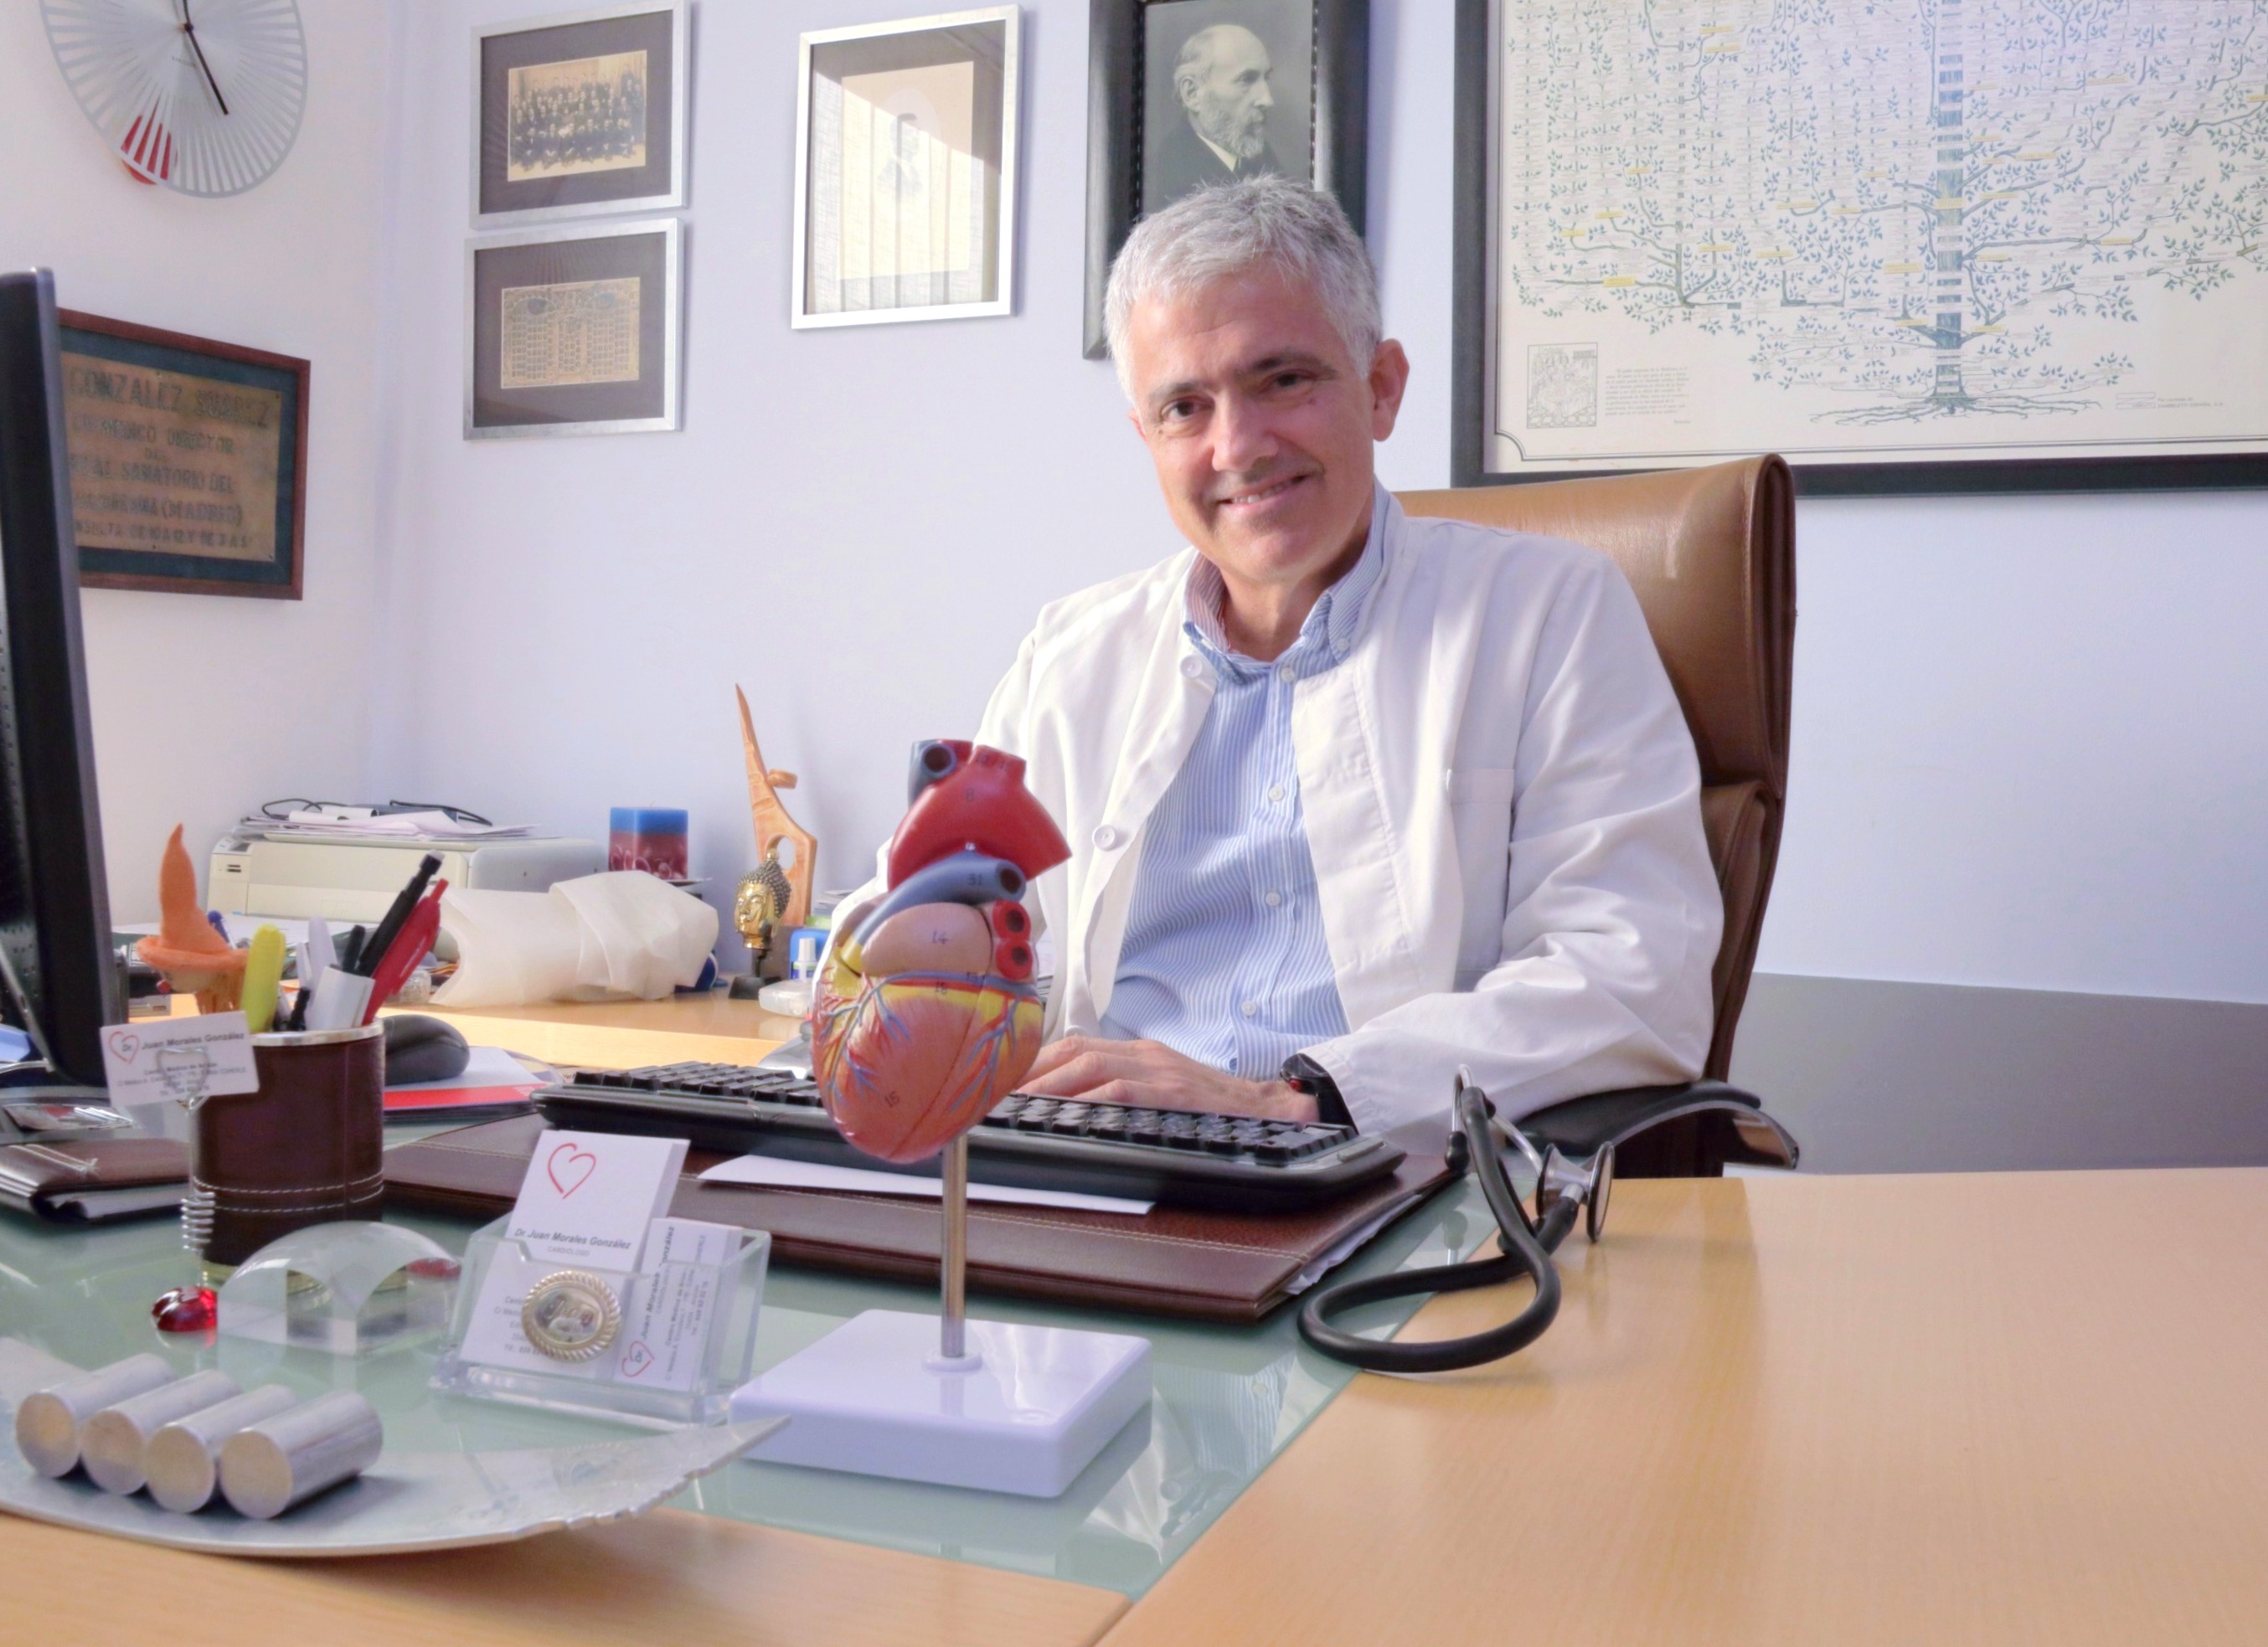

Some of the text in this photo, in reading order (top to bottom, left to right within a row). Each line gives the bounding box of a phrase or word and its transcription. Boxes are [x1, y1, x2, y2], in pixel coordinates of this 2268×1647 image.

[968, 873, 982, 886] 31
[932, 929, 949, 944] 14
[142, 1041, 163, 1049] Juan
[168, 1037, 201, 1046] Morales
[884, 1090, 900, 1108] 15
[514, 1228, 631, 1249] Dr. Juan Morales González
[641, 1314, 651, 1339] Juan
